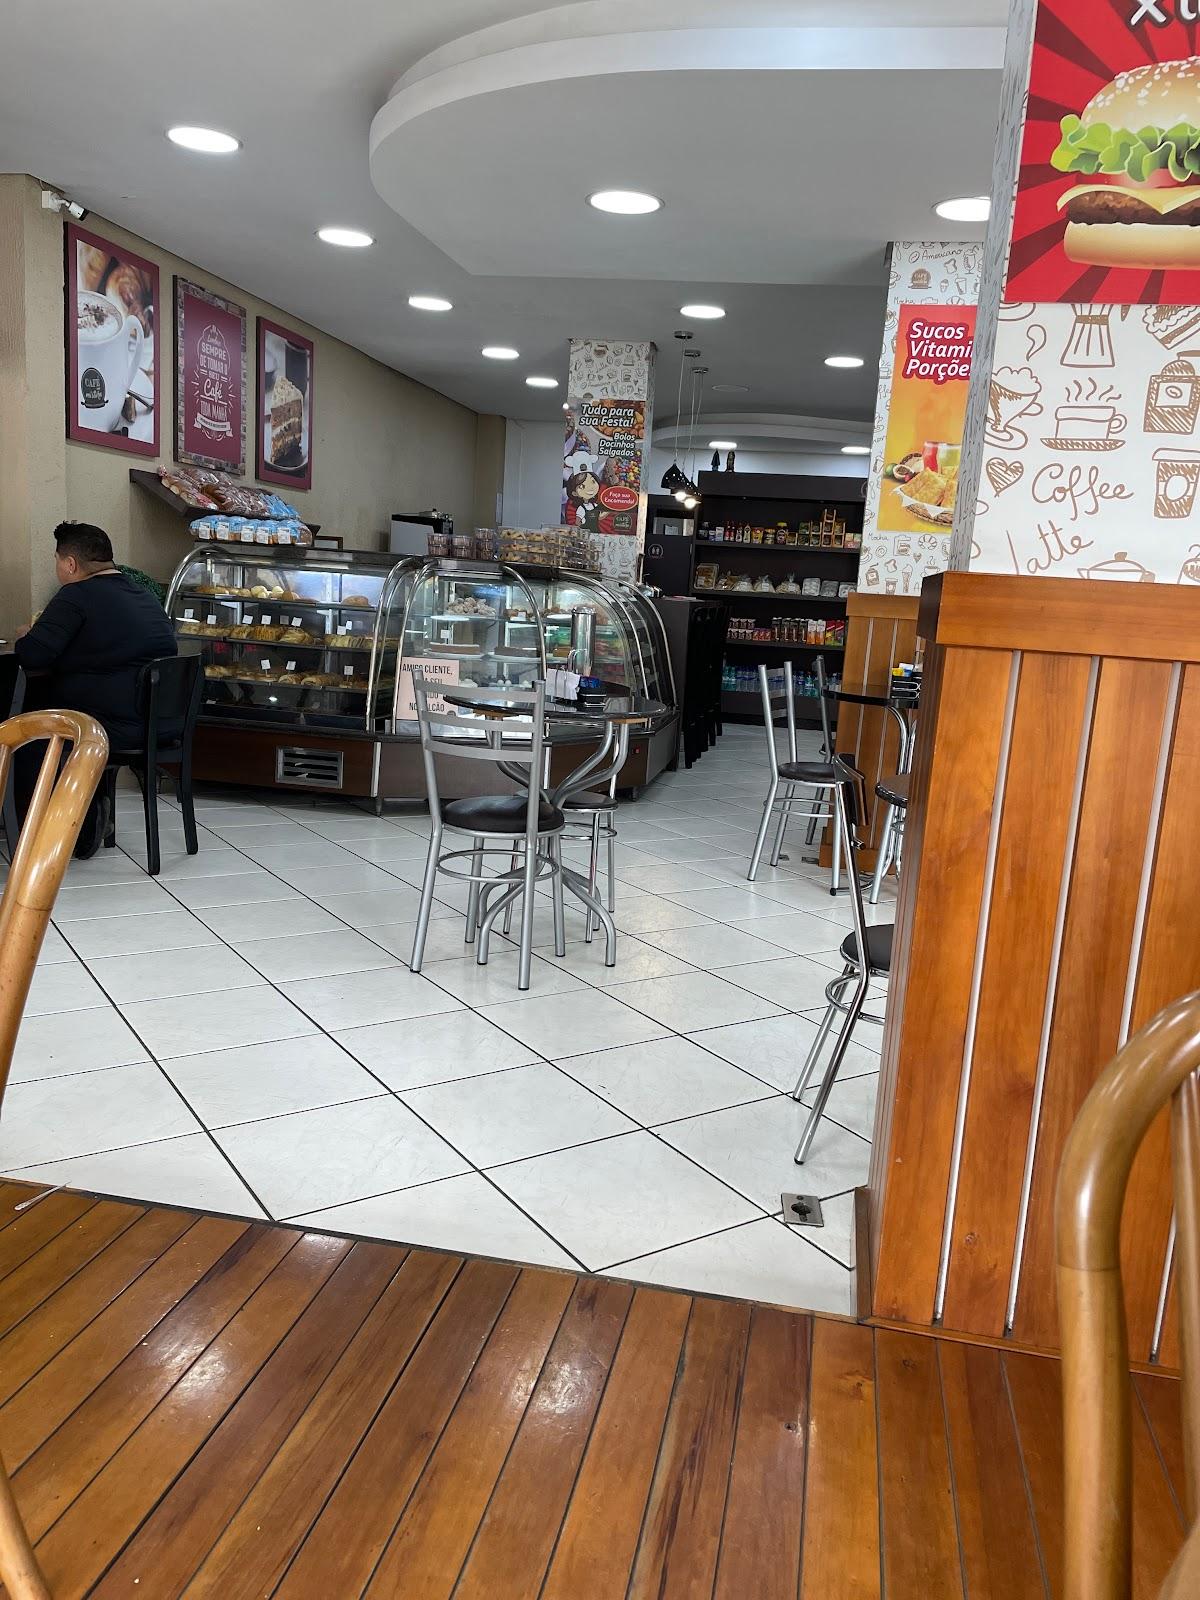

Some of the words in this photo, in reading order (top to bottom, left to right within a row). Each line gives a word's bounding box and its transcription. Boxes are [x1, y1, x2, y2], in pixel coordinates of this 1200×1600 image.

[910, 321, 965, 339] Sucos
[201, 342, 227, 361] SEMPRE
[910, 340, 973, 358] Vitami
[200, 354, 207, 368] DE
[207, 357, 224, 374] TOMAR
[906, 358, 972, 380] Porçõe
[208, 370, 220, 380] SEU
[204, 378, 223, 402] Café
[581, 404, 608, 415] Tudo
[608, 408, 634, 418] para
[579, 417, 599, 426] sua
[600, 416, 634, 427] Festa!
[599, 440, 635, 449] Docinhos
[613, 432, 636, 441] Bolos
[598, 447, 635, 457] Salgados
[1031, 462, 1134, 521] Coffee
[424, 665, 453, 676] CLIENTE,
